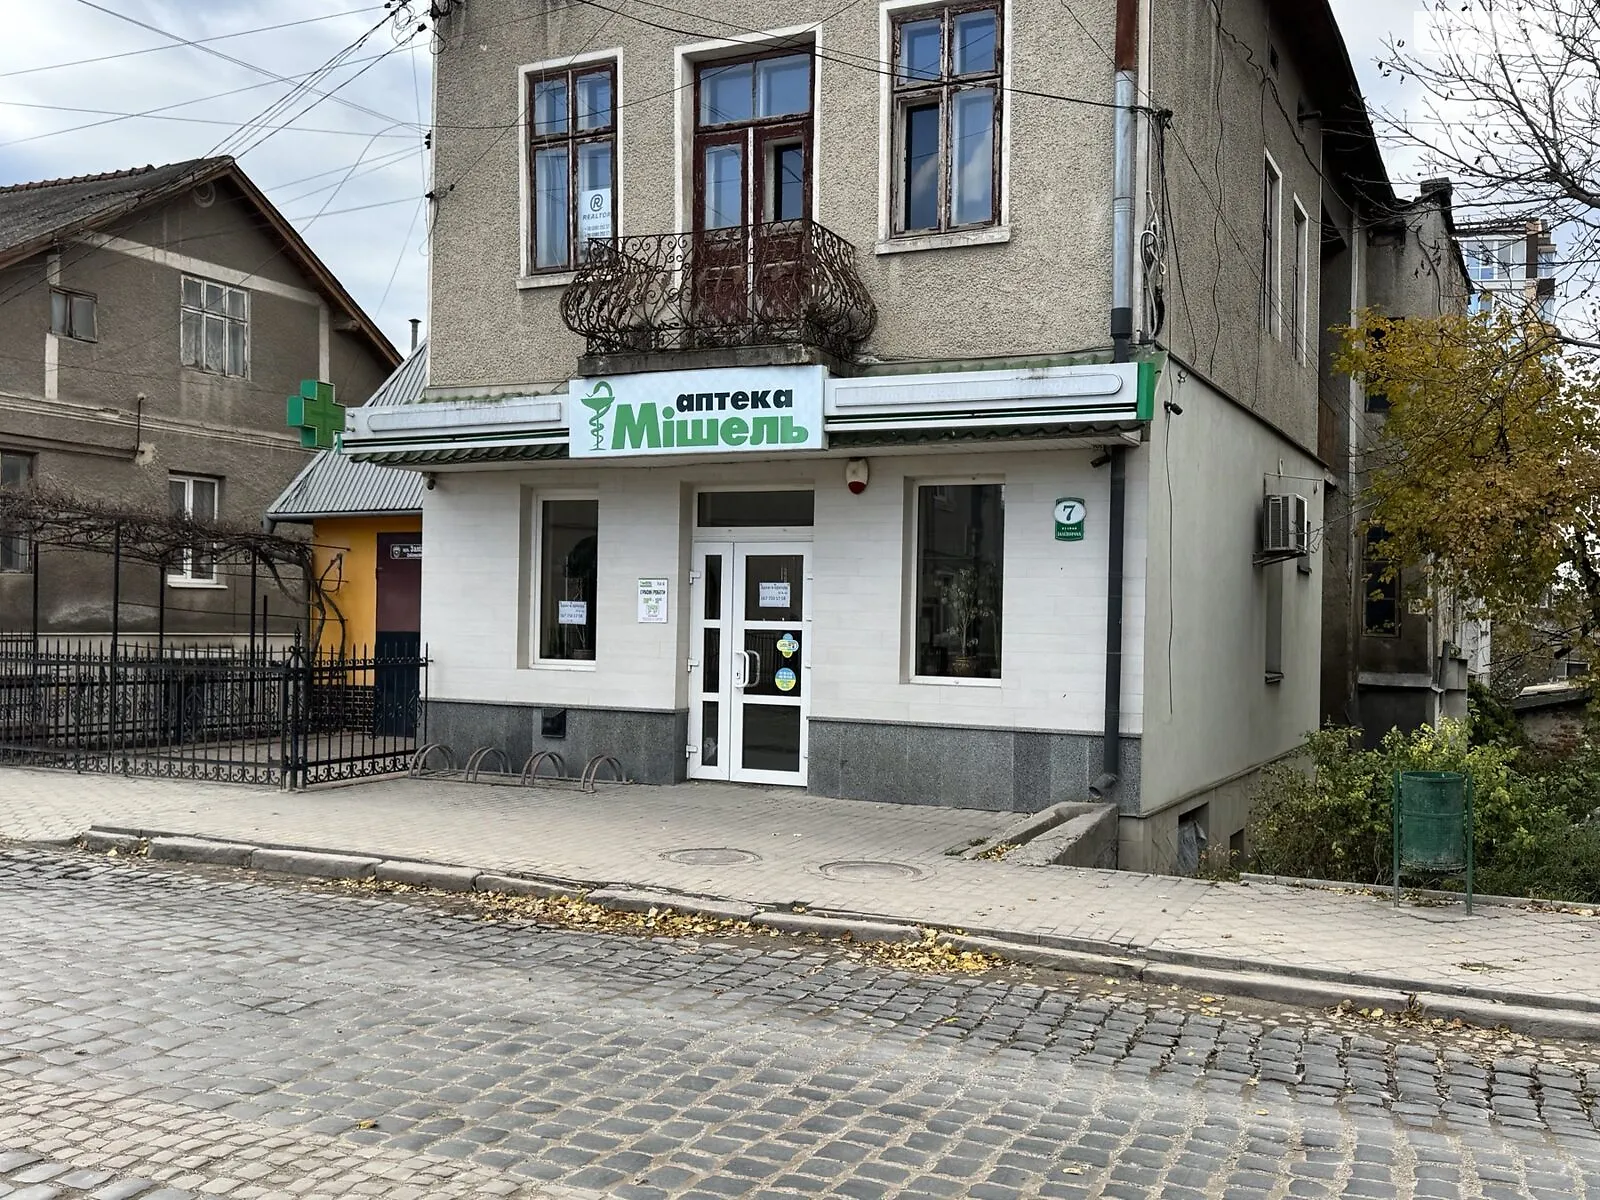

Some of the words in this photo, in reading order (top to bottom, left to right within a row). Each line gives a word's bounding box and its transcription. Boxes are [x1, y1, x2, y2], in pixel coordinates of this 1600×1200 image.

[676, 389, 793, 413] аптека
[611, 402, 809, 450] Мішель
[1063, 505, 1076, 521] 7
